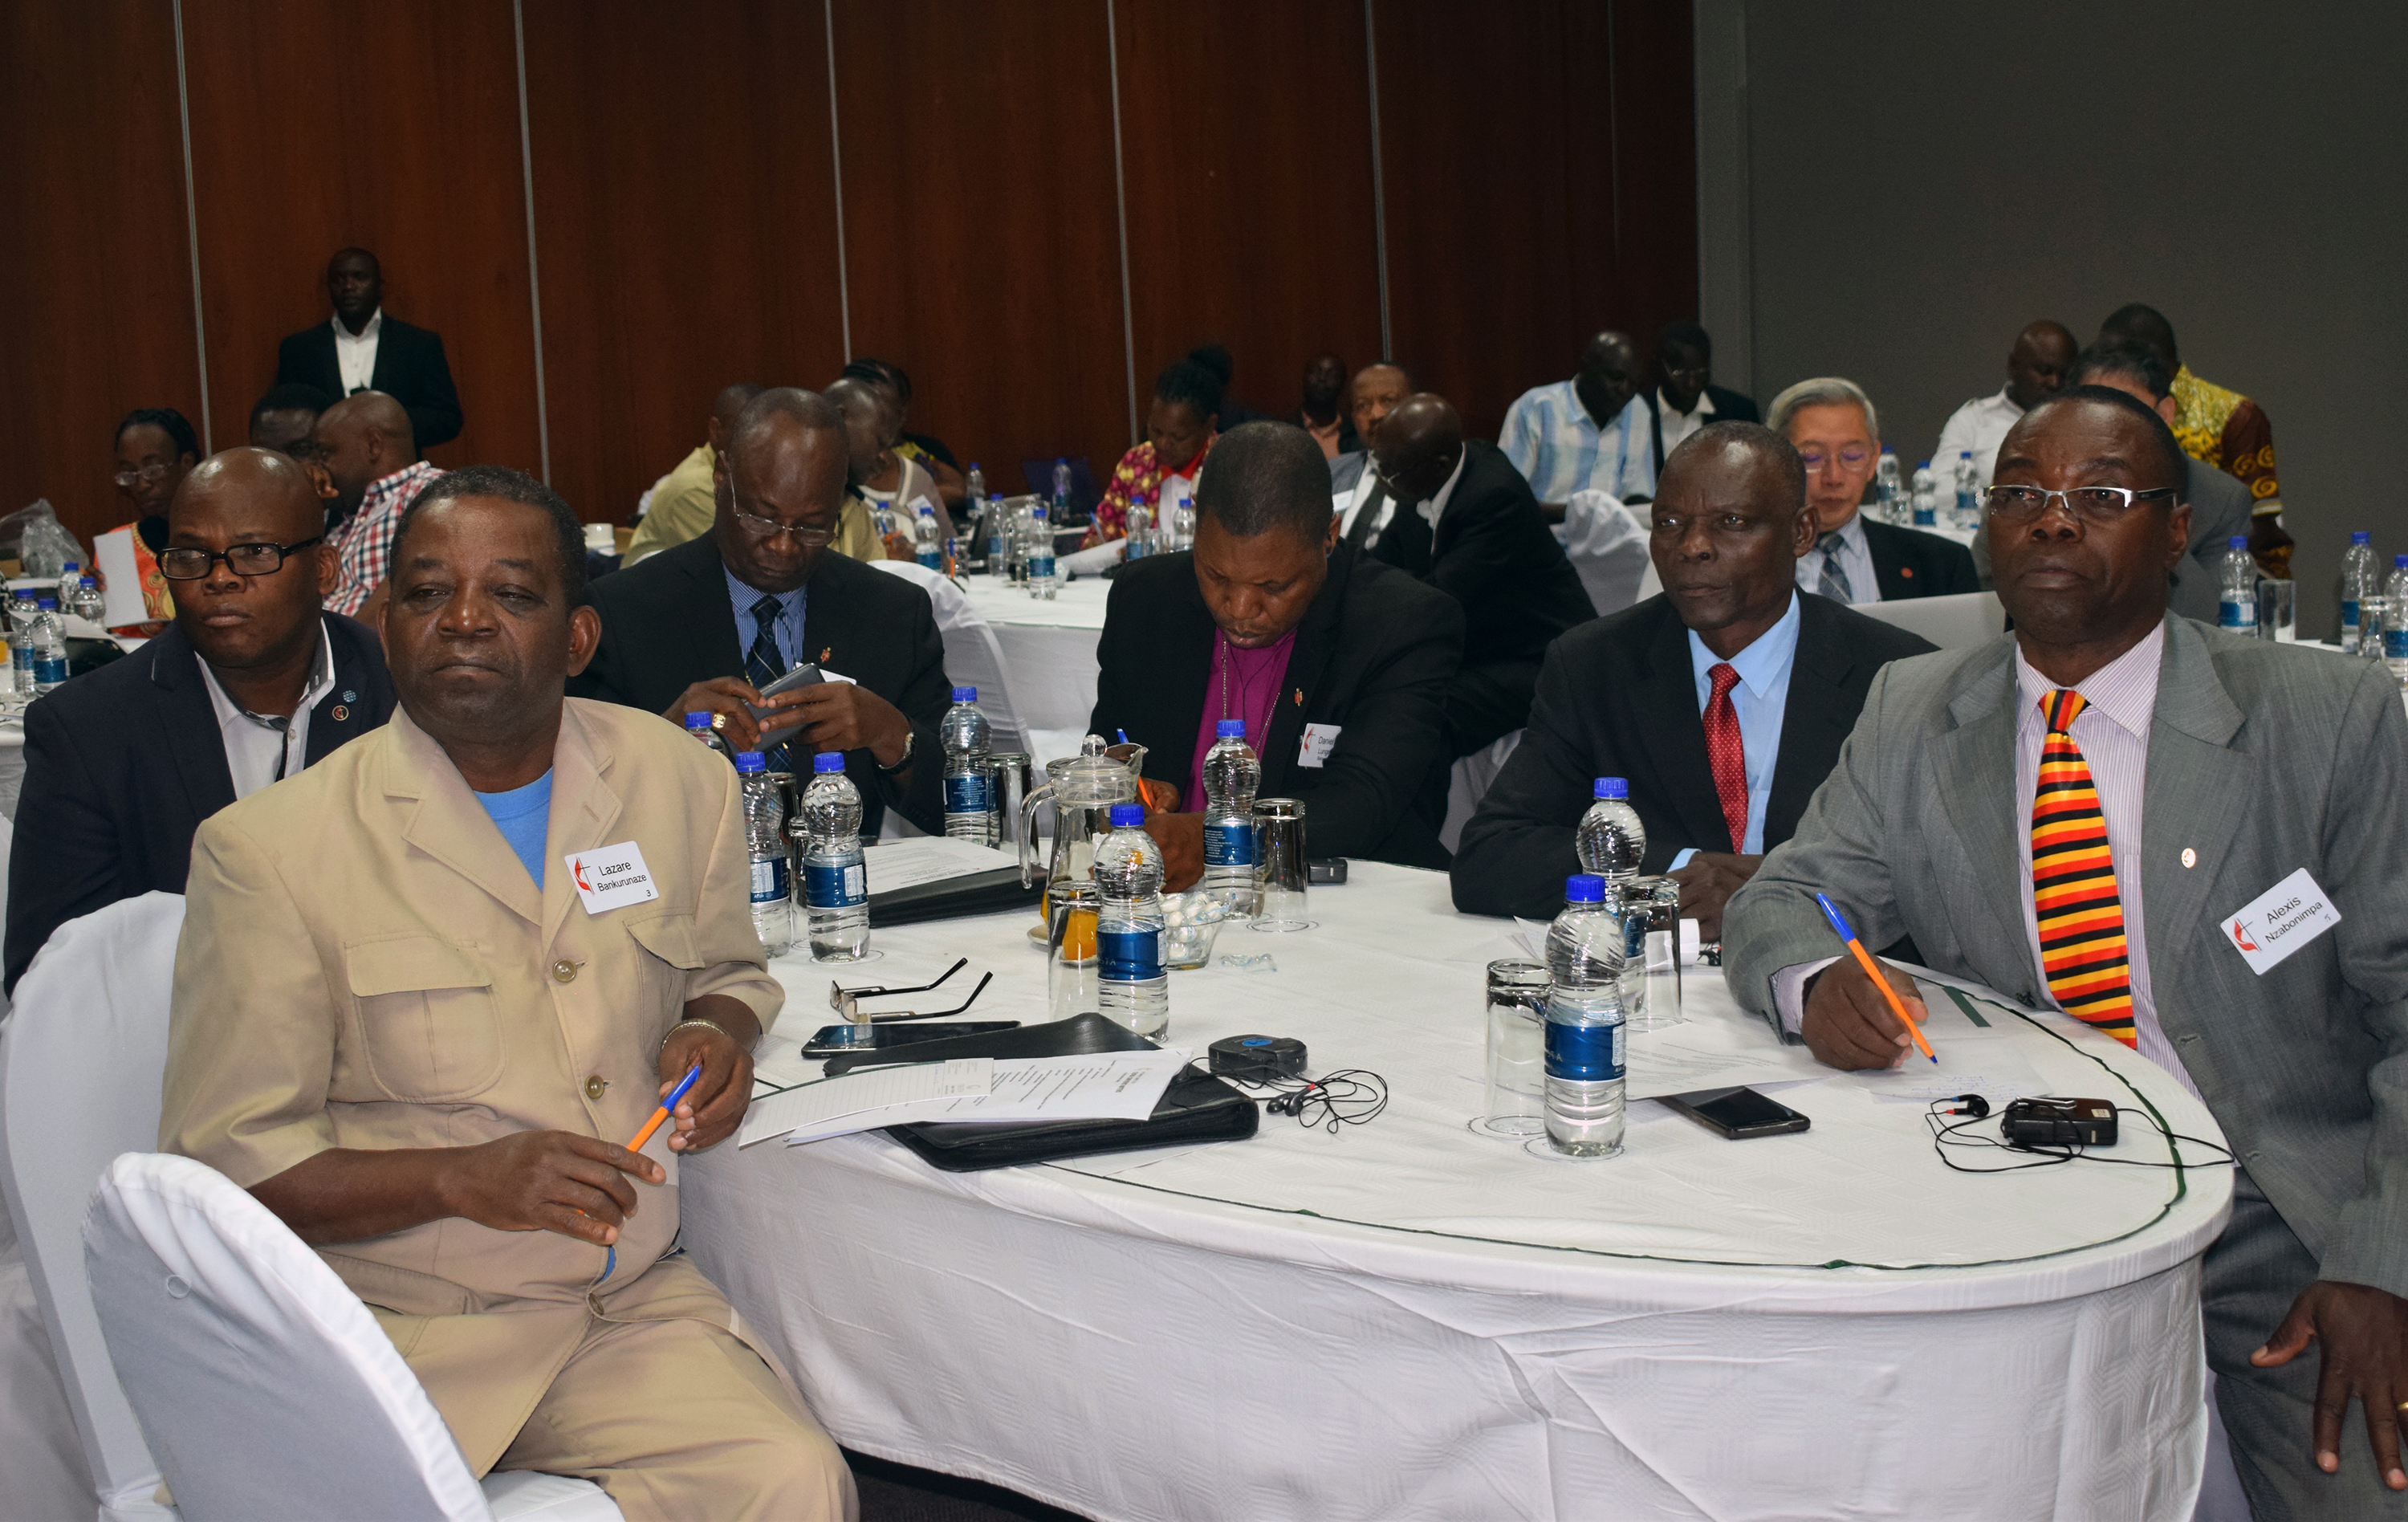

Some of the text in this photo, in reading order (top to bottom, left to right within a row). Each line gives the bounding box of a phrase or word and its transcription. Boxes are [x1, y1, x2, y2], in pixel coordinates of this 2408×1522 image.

[1318, 736, 1334, 745] Daniel
[598, 861, 632, 877] Lazare
[646, 889, 652, 897] 3
[2266, 897, 2301, 924] Alexis
[2264, 901, 2323, 943] Nzabonimpa
